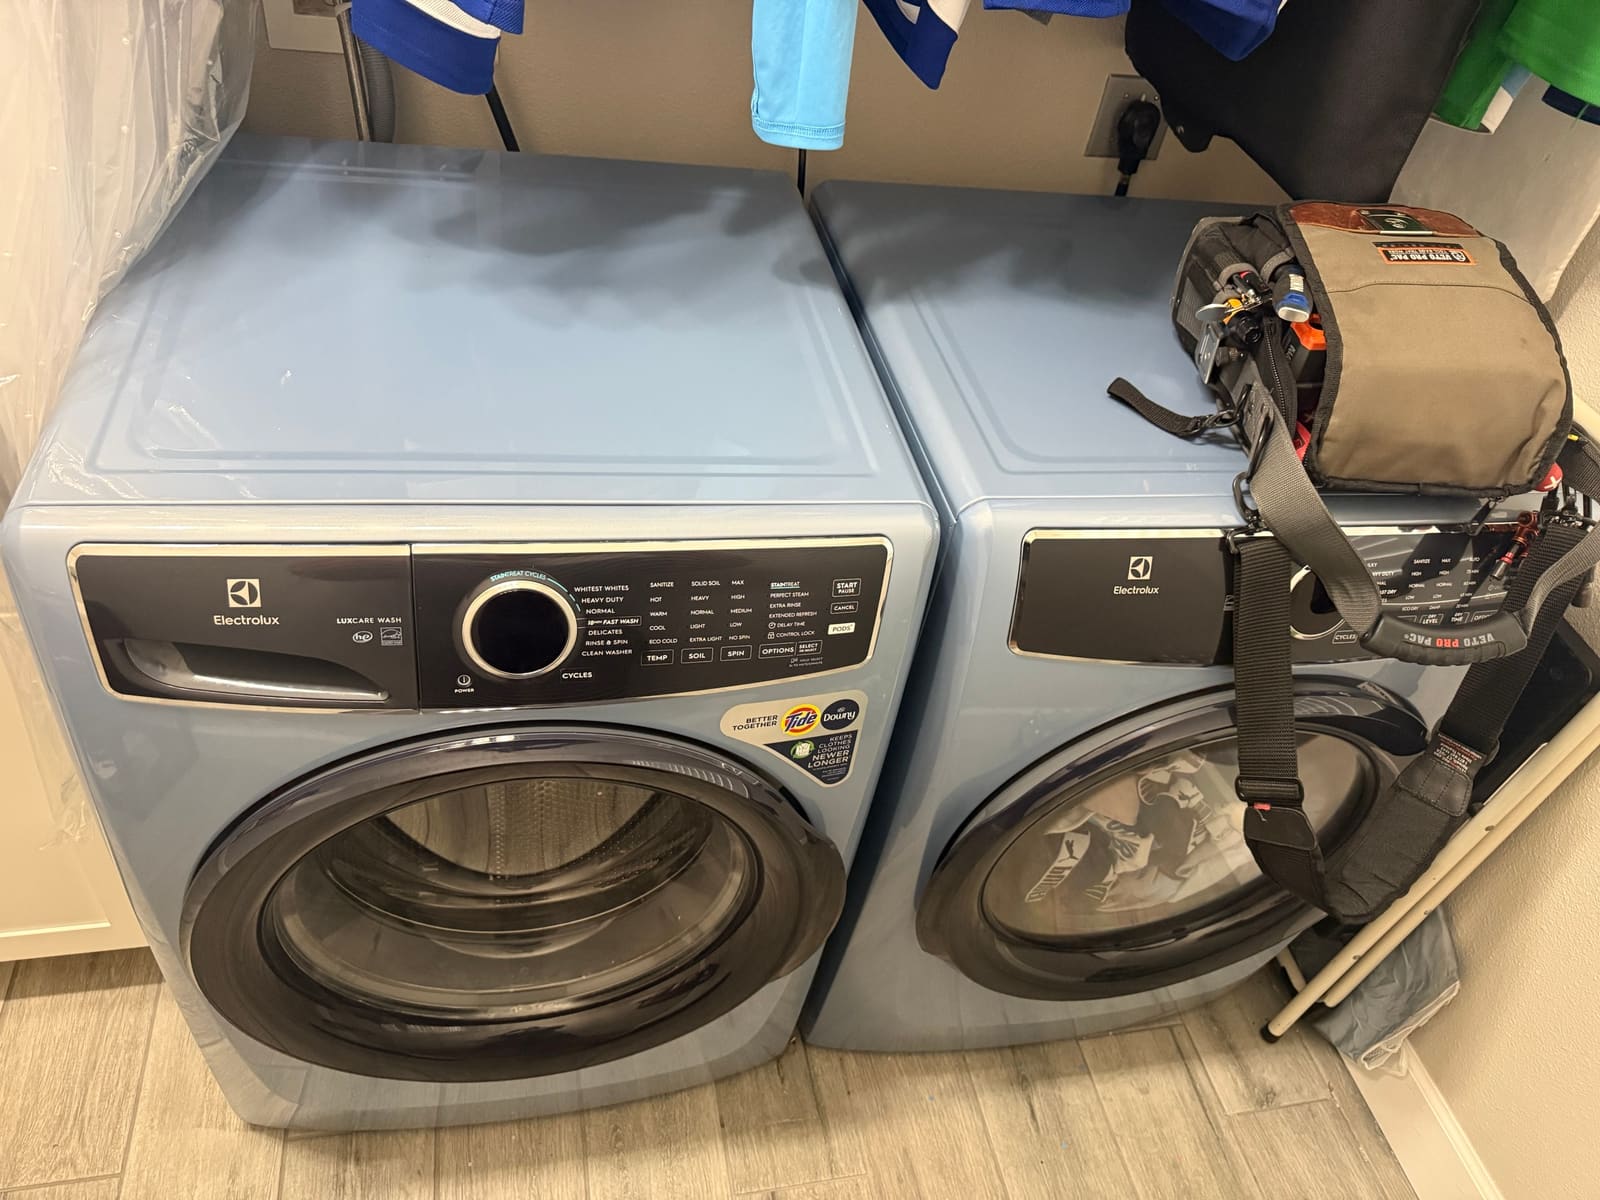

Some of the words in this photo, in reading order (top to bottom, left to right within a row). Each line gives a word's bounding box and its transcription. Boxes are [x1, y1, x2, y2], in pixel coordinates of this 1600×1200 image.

[524, 570, 546, 580] CYCLES
[574, 585, 603, 593] WHITEST
[836, 581, 858, 589] START
[1113, 585, 1160, 595] Electrolux
[213, 614, 280, 626] Electrolux
[336, 617, 375, 625] LUXCARE
[1435, 638, 1460, 648] PRO
[1463, 632, 1495, 647] VETO
[762, 646, 794, 655] OPTIONS
[688, 652, 706, 660] SOIL
[562, 671, 593, 679] CYCLES
[745, 714, 778, 724] BETTER
[823, 710, 856, 721] Downy
[732, 720, 777, 731] TOGETHER
[784, 711, 818, 732] Tide
[817, 744, 850, 754] LOOKING
[818, 739, 851, 749] CLOTHES
[812, 750, 850, 761] NEWER
[807, 756, 849, 768] LONGER
